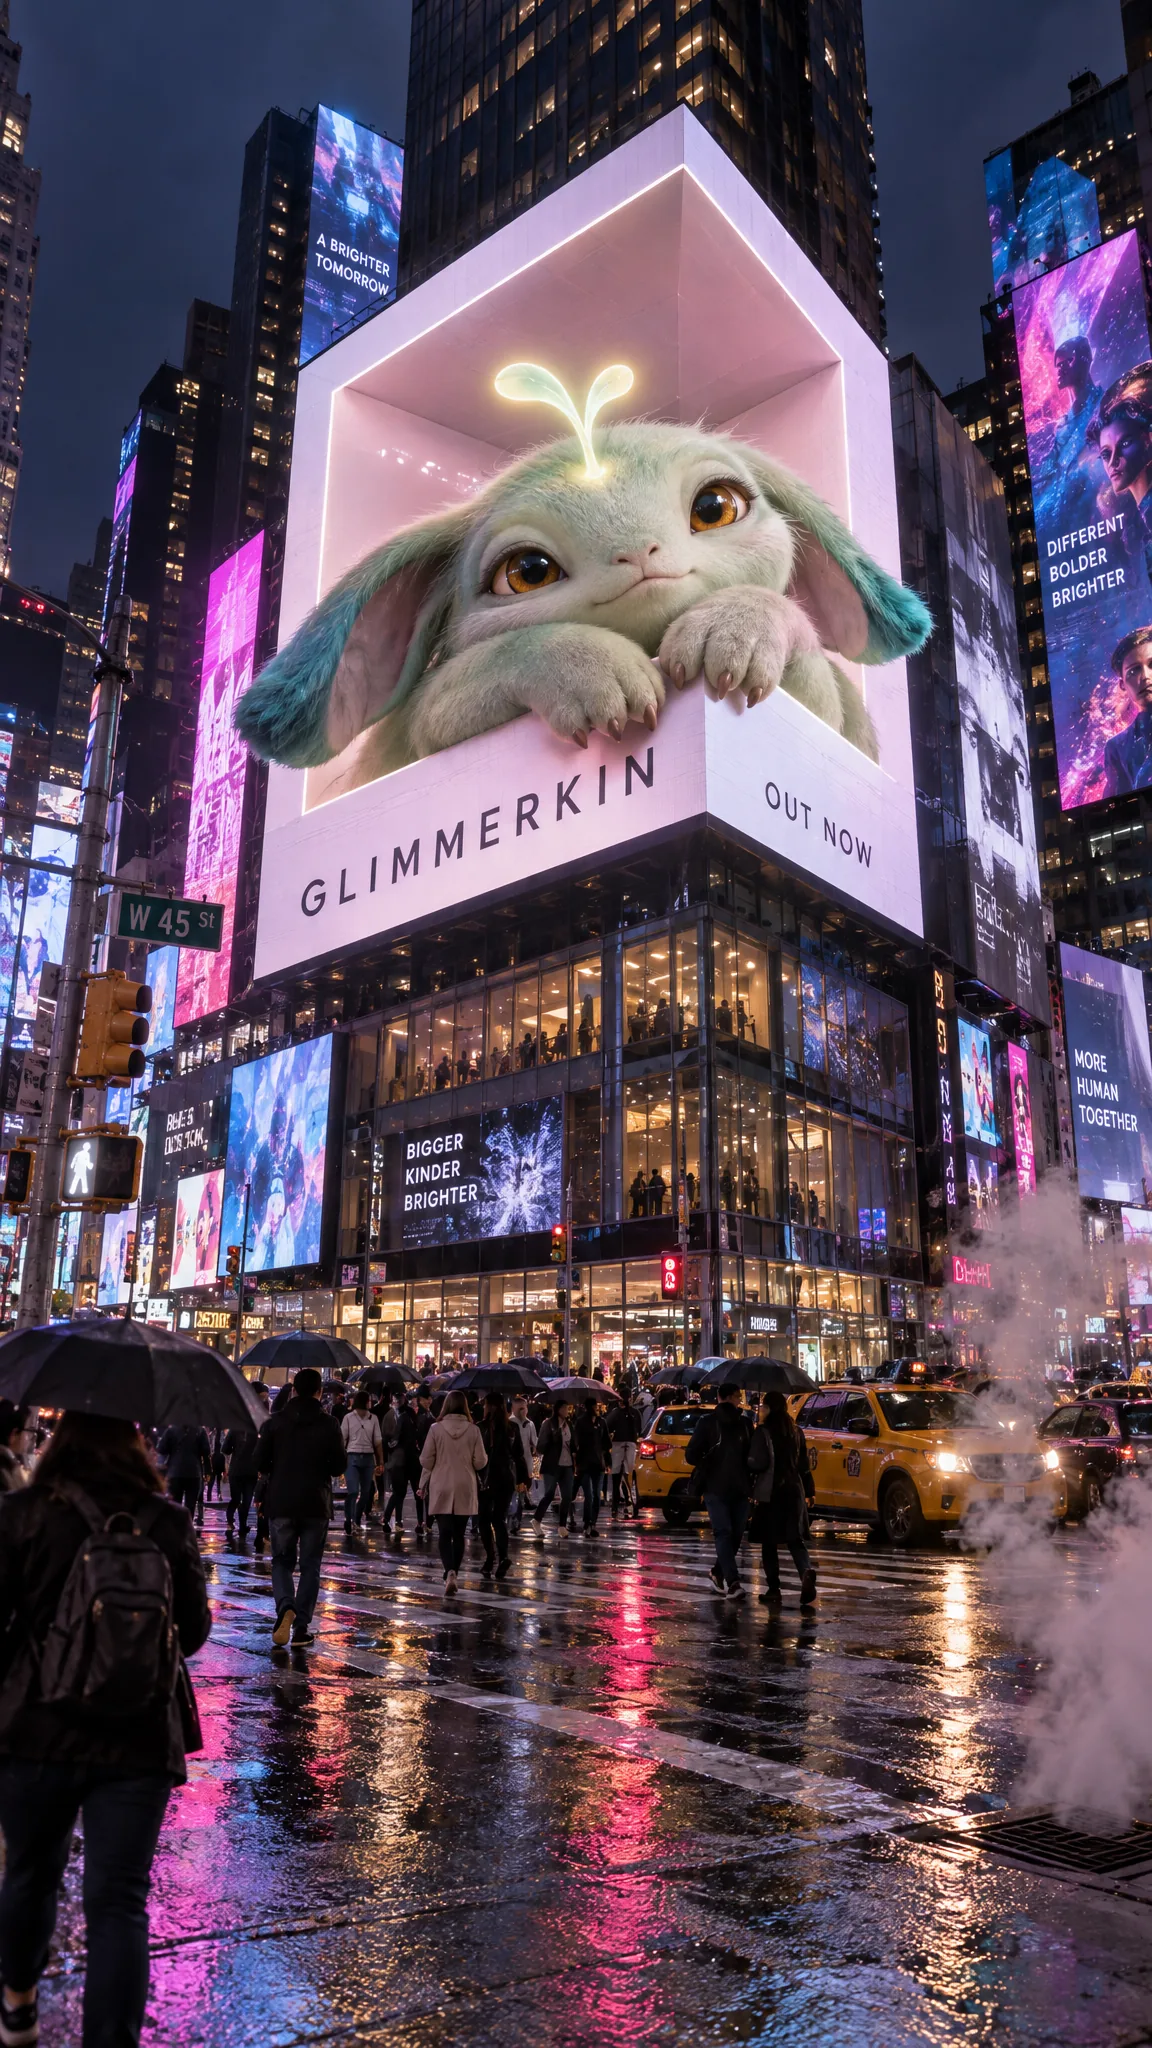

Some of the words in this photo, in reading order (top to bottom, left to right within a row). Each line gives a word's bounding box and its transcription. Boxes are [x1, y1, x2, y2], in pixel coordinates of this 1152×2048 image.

[316, 233, 326, 248] A
[330, 238, 390, 278] BRIGHTER
[315, 252, 390, 296] TOMORROW
[1047, 512, 1125, 557] DIFFERENT
[1049, 547, 1108, 583] BOLDER
[1052, 567, 1126, 609] BRIGHTER
[301, 746, 656, 917] GLIMMERKIN
[765, 781, 812, 830] OUT
[823, 815, 873, 868] NOW
[129, 903, 151, 931] W
[157, 907, 190, 938] 45
[198, 911, 215, 929] St
[1074, 1048, 1108, 1073] MORE
[1076, 1076, 1119, 1102] HUMAN
[1078, 1104, 1139, 1133] TOGETHER
[406, 1133, 464, 1160] BIGGER
[405, 1160, 461, 1186] KINDER
[404, 1183, 478, 1212] BRIGHTER
